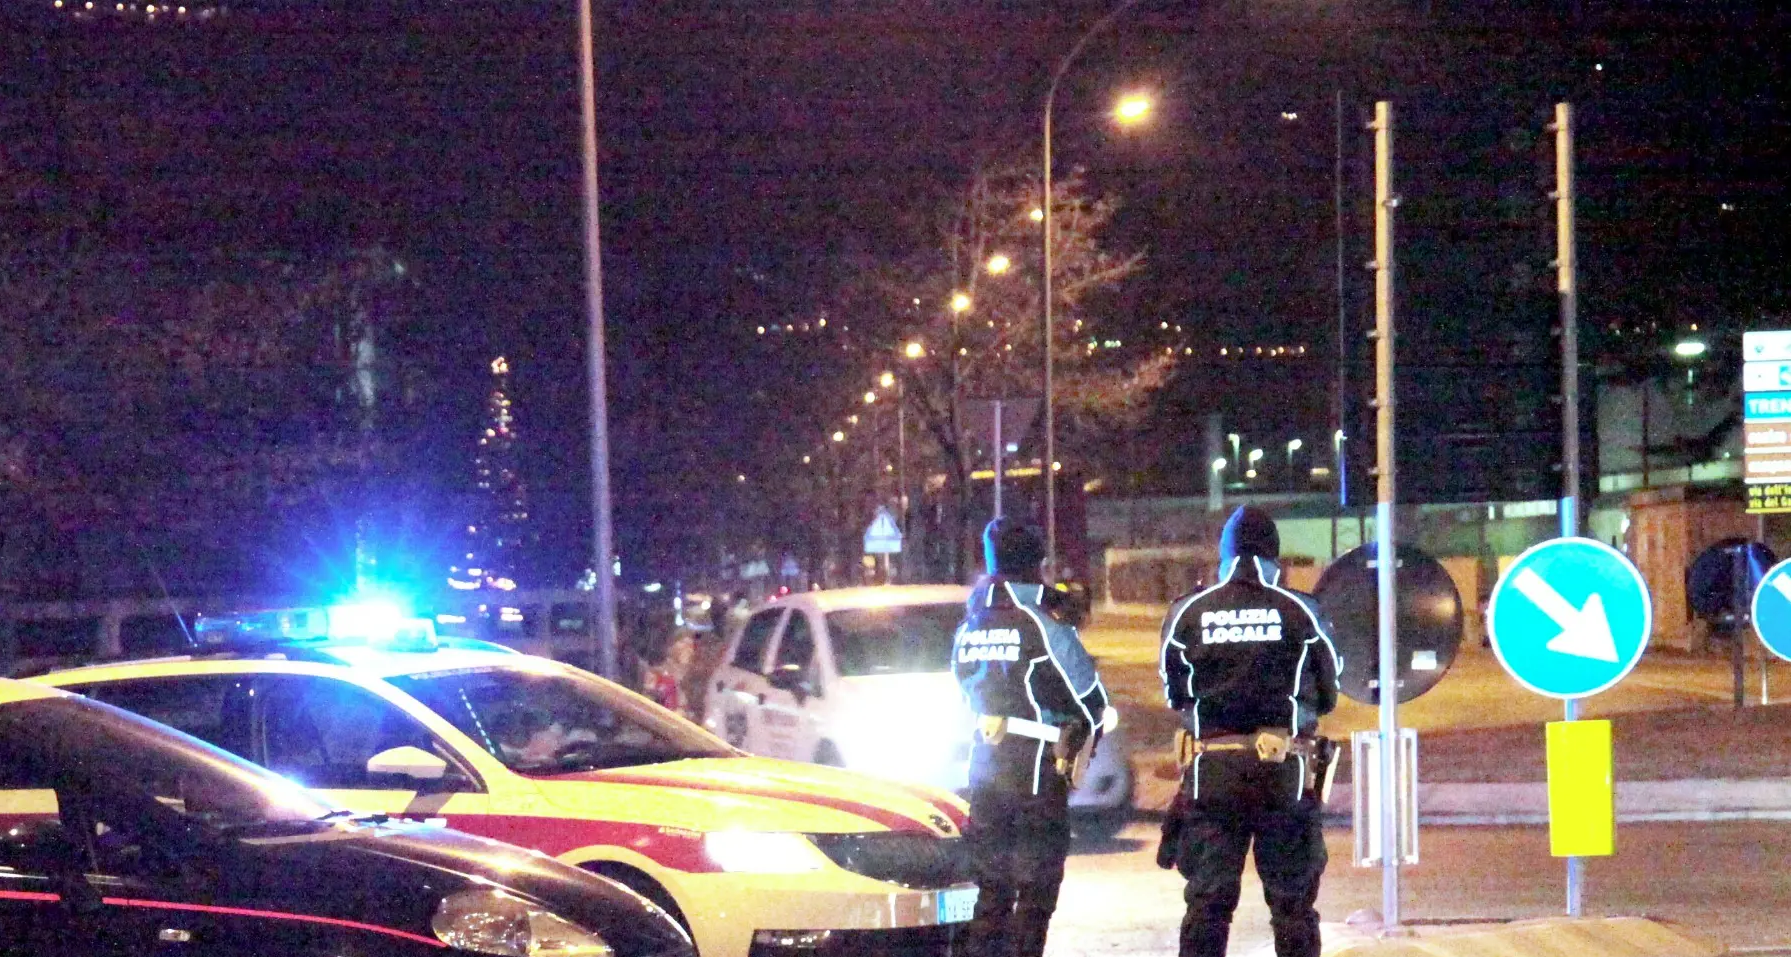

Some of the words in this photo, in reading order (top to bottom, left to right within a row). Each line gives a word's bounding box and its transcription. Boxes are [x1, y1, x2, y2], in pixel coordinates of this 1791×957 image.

[1200, 608, 1282, 628] POLIZIA
[959, 628, 1021, 646] POLIZIA
[1201, 625, 1283, 645] LOCALE
[958, 645, 1021, 663] LOCALE
